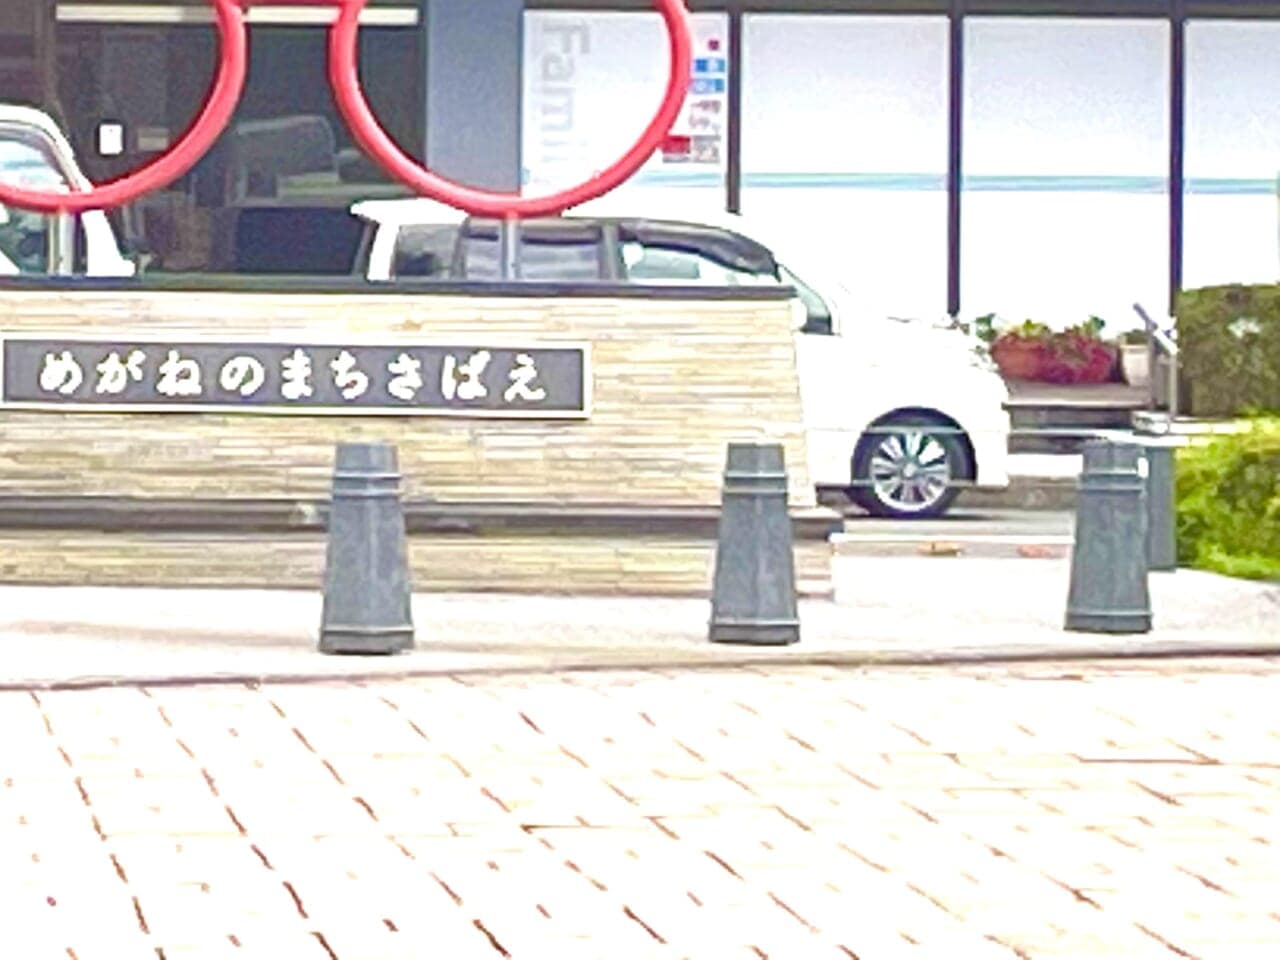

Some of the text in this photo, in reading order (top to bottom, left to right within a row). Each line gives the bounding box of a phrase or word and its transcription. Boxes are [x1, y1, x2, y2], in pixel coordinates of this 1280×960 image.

[39, 348, 547, 403] めがねのまちさばえ
